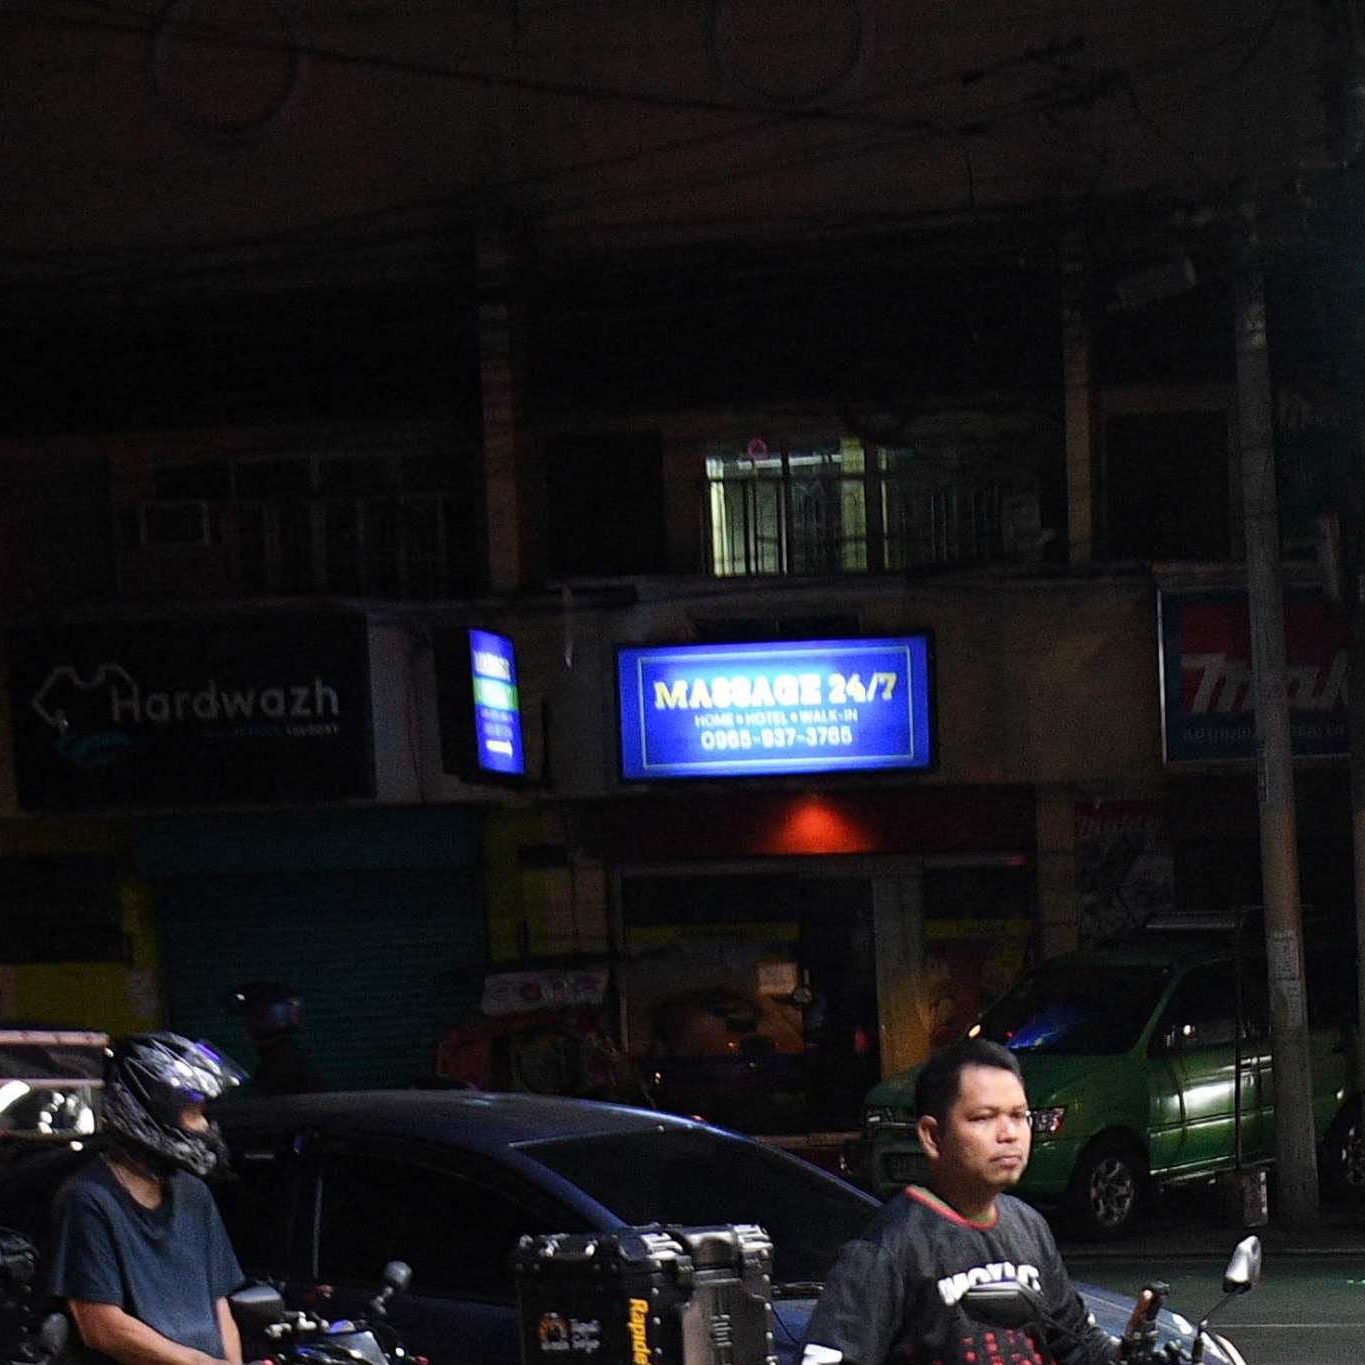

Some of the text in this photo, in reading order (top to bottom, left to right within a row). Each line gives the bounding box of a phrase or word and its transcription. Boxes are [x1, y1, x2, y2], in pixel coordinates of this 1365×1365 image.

[110, 675, 340, 722] Hardwazh
[654, 671, 897, 710] MASSAGE 24/7
